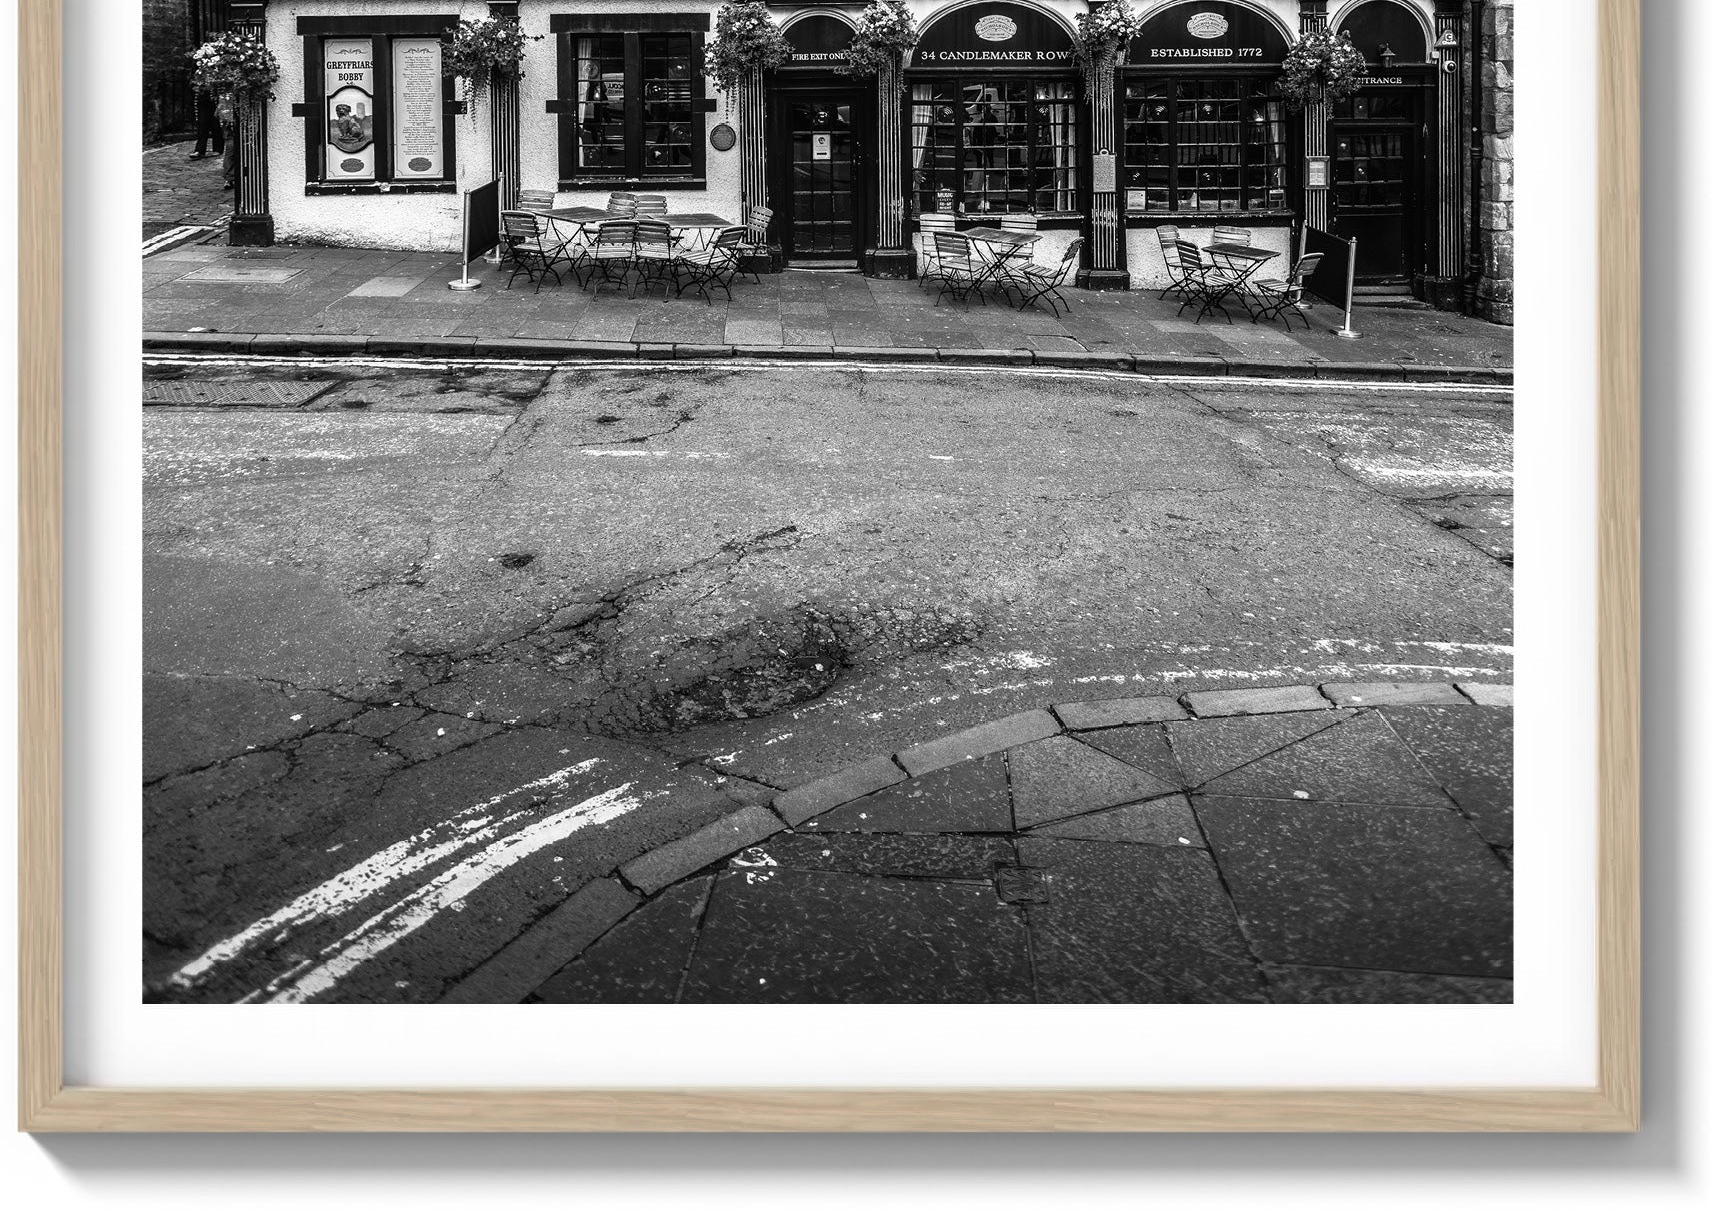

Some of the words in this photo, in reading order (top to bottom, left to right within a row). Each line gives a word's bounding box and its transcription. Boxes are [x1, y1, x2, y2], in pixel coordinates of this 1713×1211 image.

[791, 53, 809, 61] FIRE
[828, 52, 847, 60] ONL
[921, 51, 936, 60] 34
[939, 51, 1032, 60] CANDLEMAKER
[1036, 51, 1070, 60] ROW
[1150, 48, 1234, 57] ESTABLISHED
[1238, 48, 1263, 57] 1772
[338, 72, 363, 81] BOBBY
